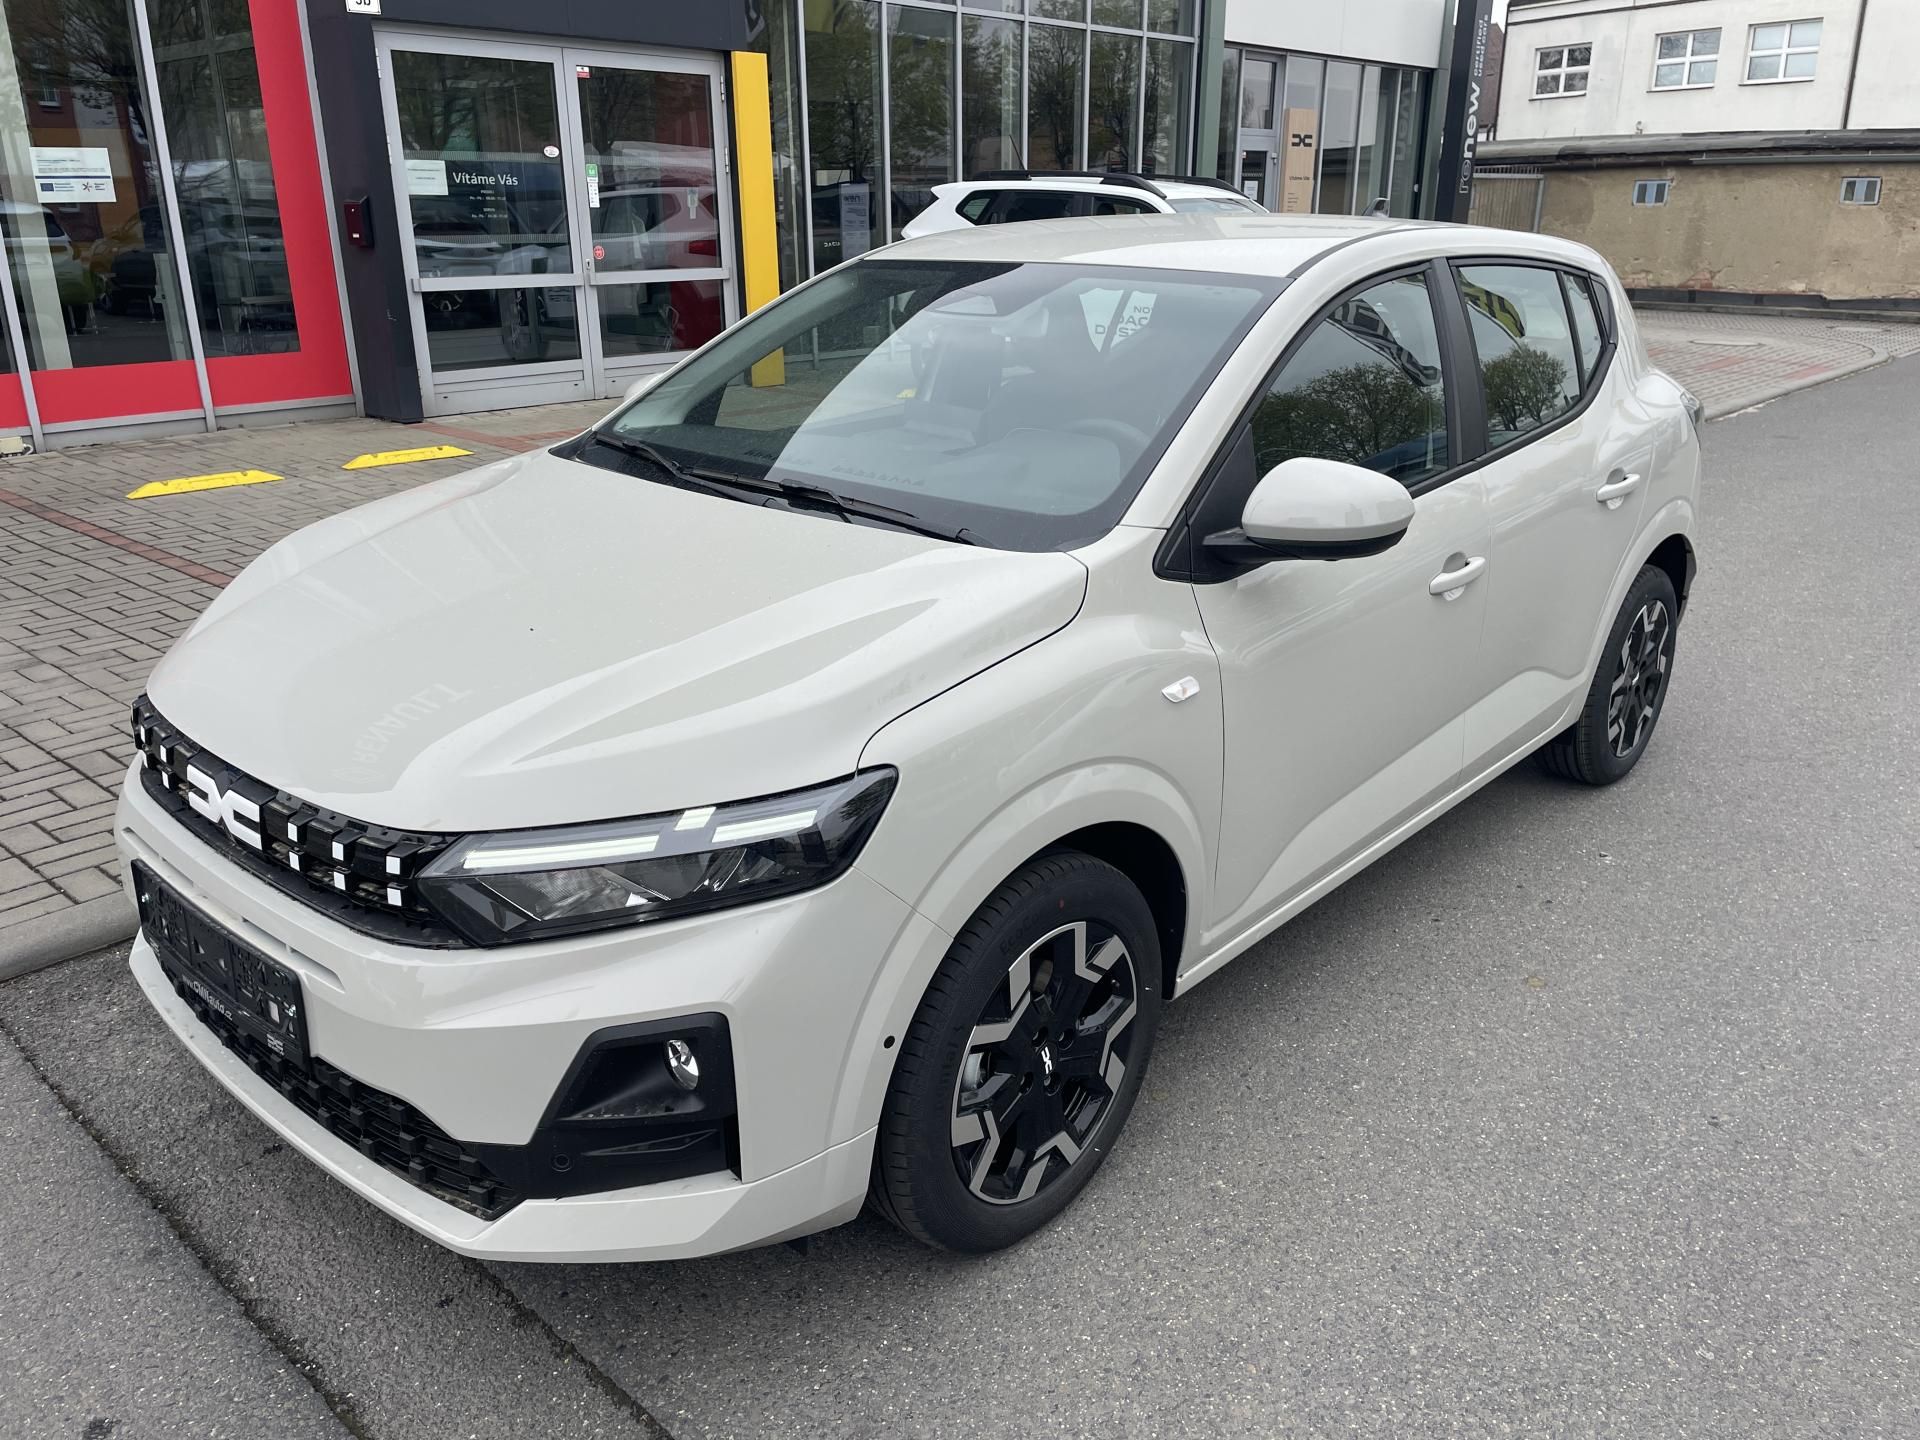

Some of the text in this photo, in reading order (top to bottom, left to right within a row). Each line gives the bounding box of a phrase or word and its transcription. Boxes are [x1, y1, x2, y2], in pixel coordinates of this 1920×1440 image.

[452, 171, 519, 186] Vítáme Vás
[1133, 305, 1152, 314] NO
